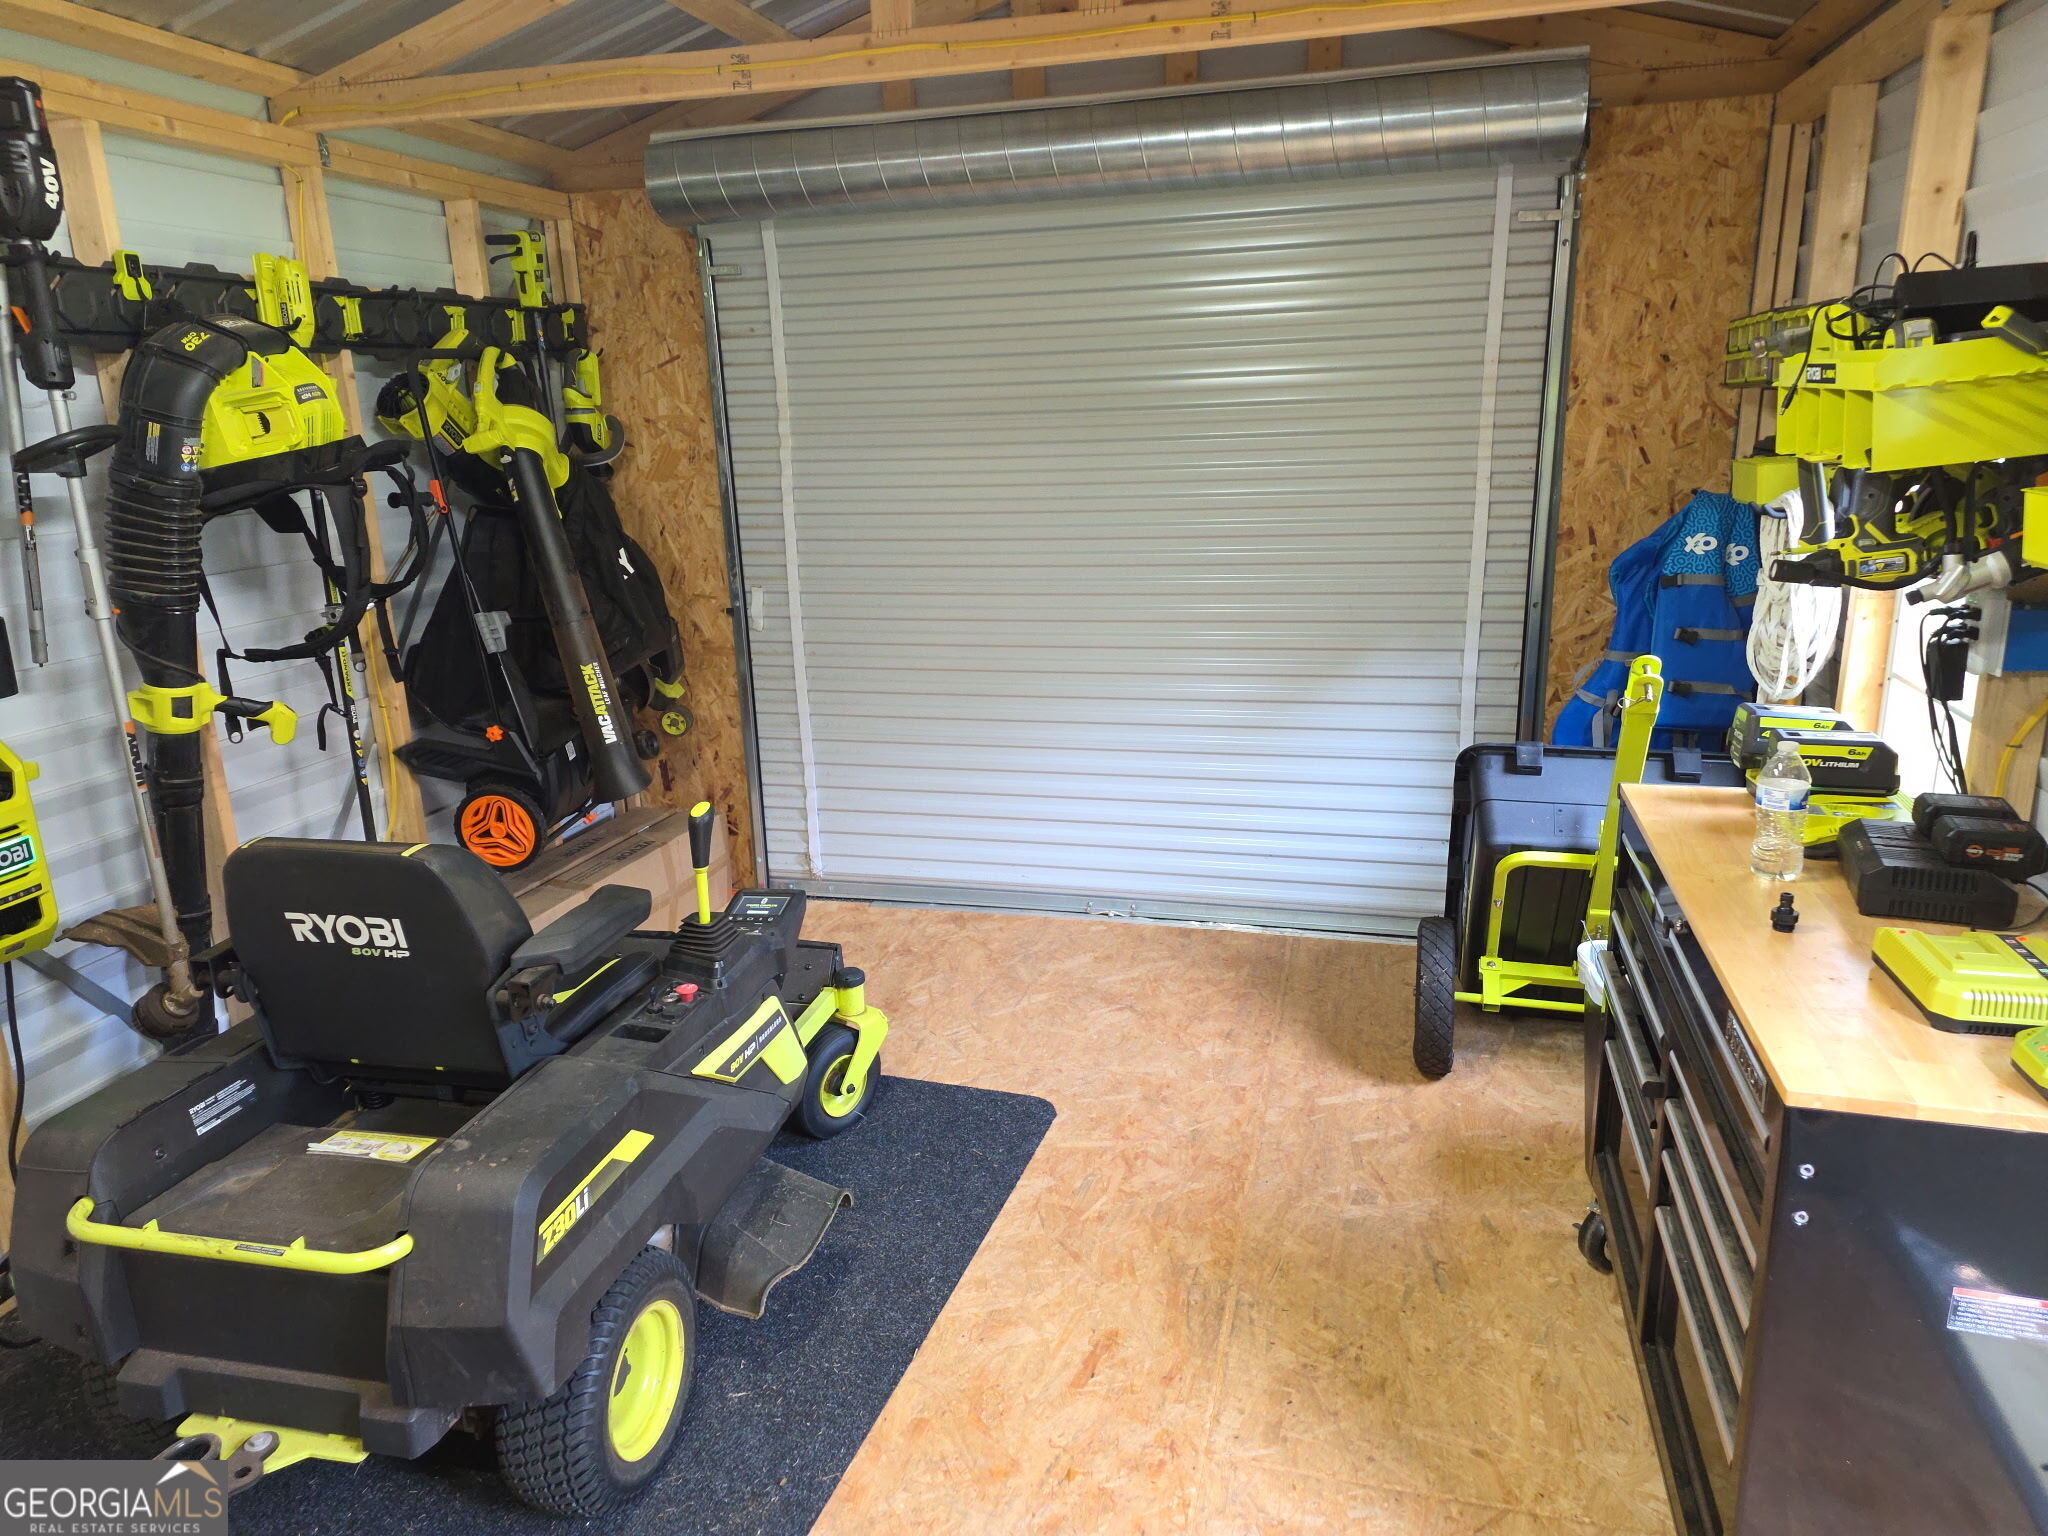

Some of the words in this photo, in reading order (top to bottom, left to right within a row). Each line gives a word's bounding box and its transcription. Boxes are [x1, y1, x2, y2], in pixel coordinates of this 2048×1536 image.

[39, 156, 60, 210] 40V
[184, 331, 211, 352] 730
[592, 661, 606, 689] MULCHER
[580, 663, 618, 745] VACATTACK
[602, 690, 611, 705] LEAF
[284, 911, 408, 949] RYOBI
[351, 947, 381, 957] 80V
[384, 949, 410, 958] HP
[744, 1041, 756, 1060] HP
